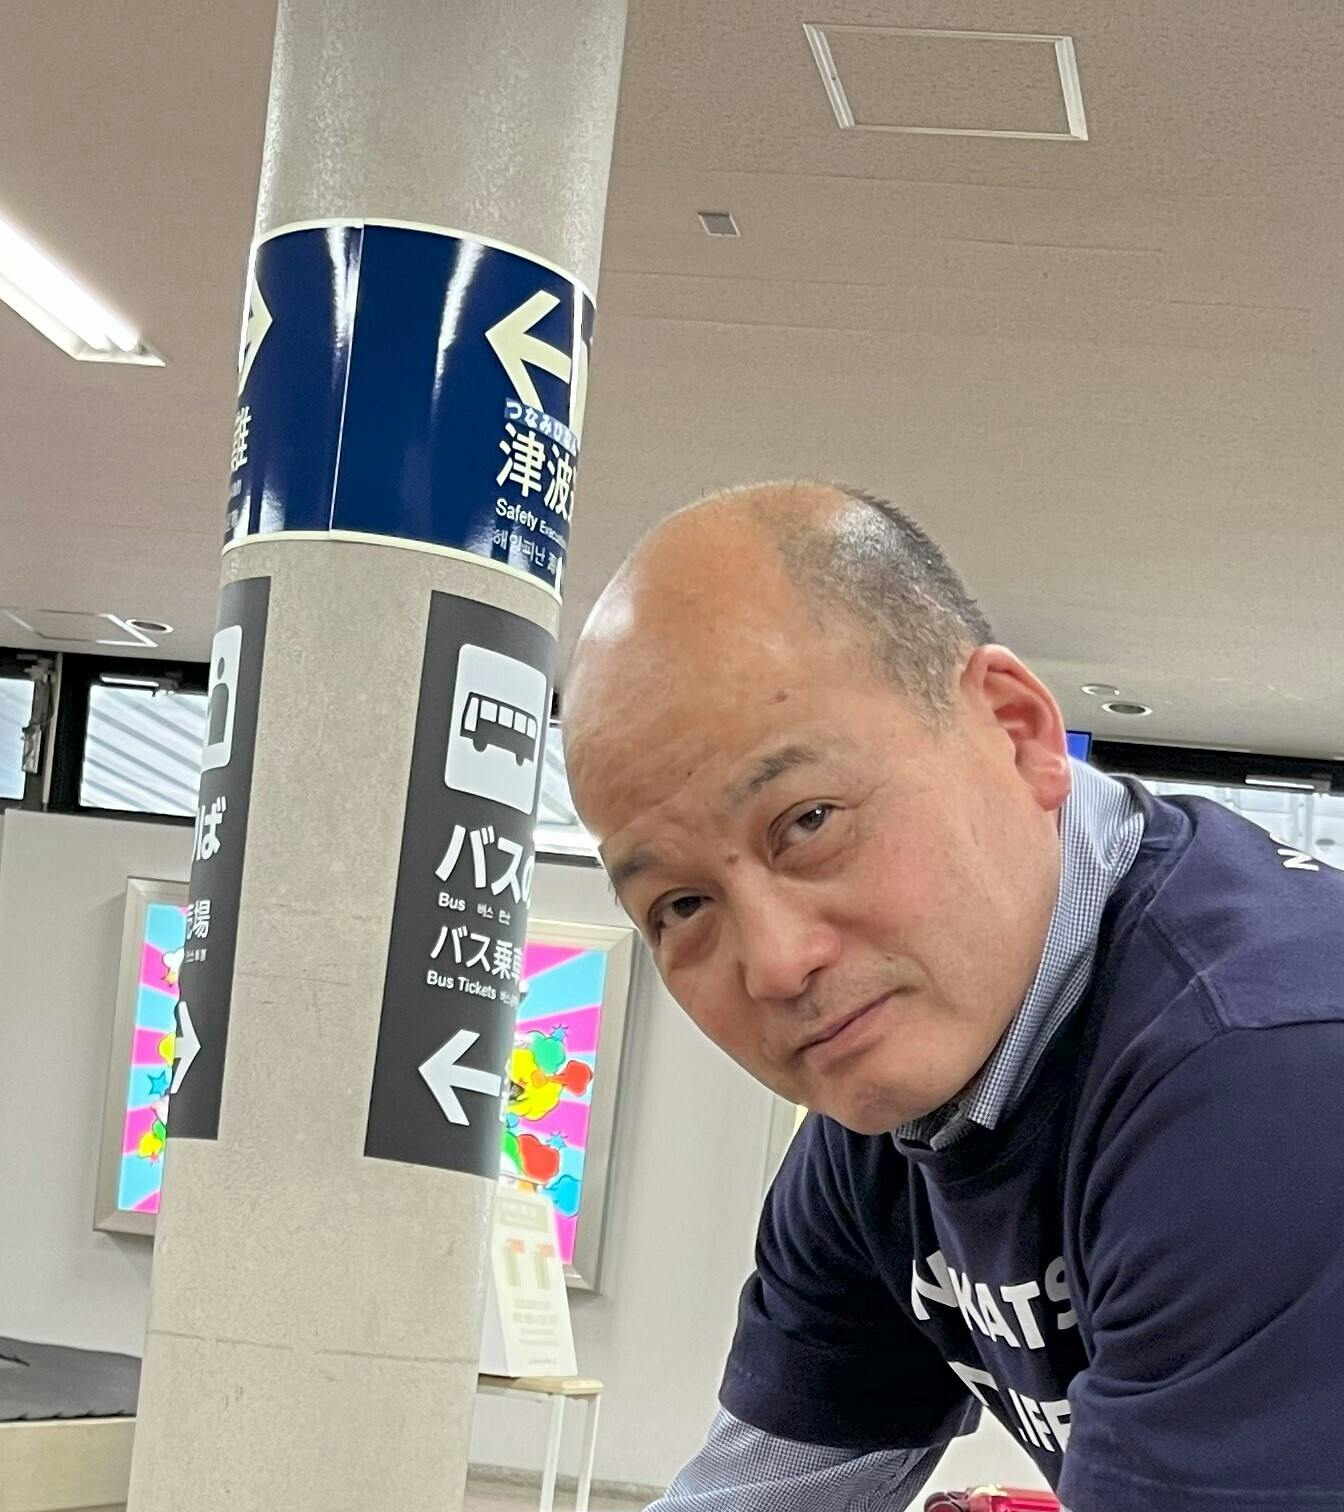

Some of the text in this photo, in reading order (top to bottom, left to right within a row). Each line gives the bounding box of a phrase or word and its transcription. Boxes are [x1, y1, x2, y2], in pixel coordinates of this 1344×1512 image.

[496, 423, 576, 522] 津波
[496, 498, 538, 532] Safety
[438, 891, 466, 911] Bus
[426, 969, 454, 989] Bus
[457, 976, 497, 1000] Tickets
